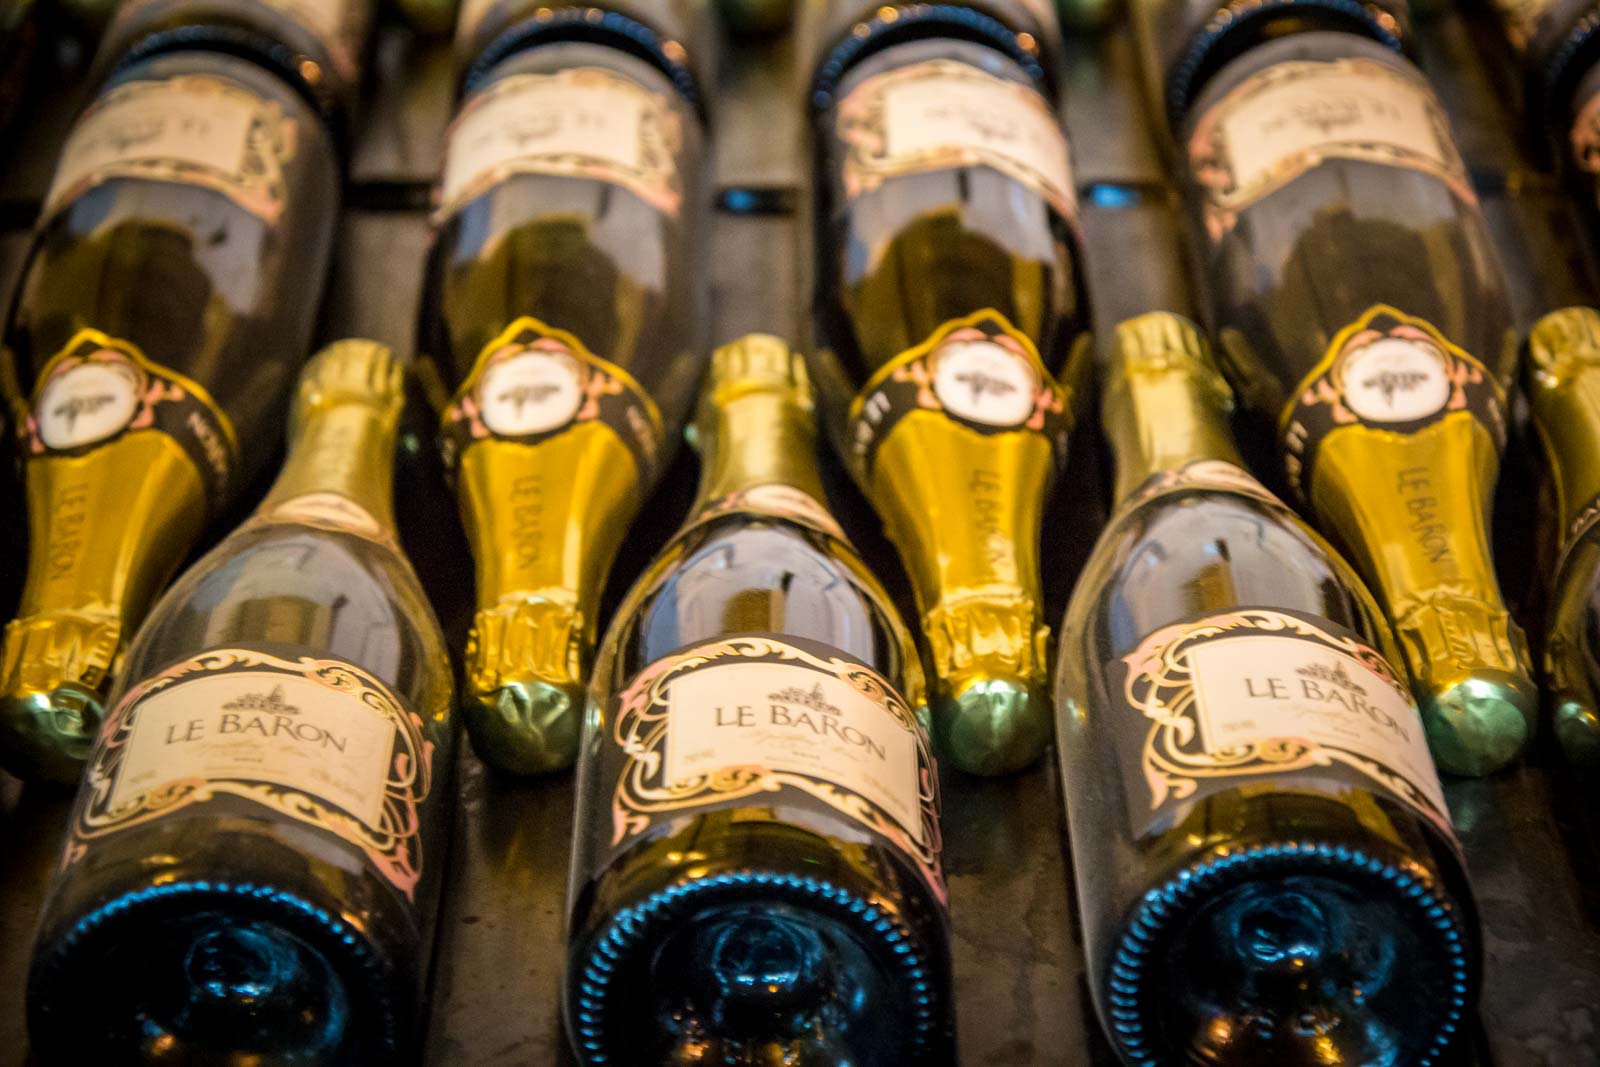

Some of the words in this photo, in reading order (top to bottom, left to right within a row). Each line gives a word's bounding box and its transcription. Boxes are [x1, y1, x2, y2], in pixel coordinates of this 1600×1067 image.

[508, 474, 543, 503] LE
[968, 469, 1001, 493] LE
[1396, 466, 1431, 496] LE
[1405, 496, 1450, 563] BARON
[1243, 677, 1290, 700] LE
[1300, 679, 1412, 744] BARON
[164, 718, 205, 746] LE
[218, 713, 348, 753] BARON
[714, 705, 757, 728] LE
[769, 704, 886, 761] BARON
